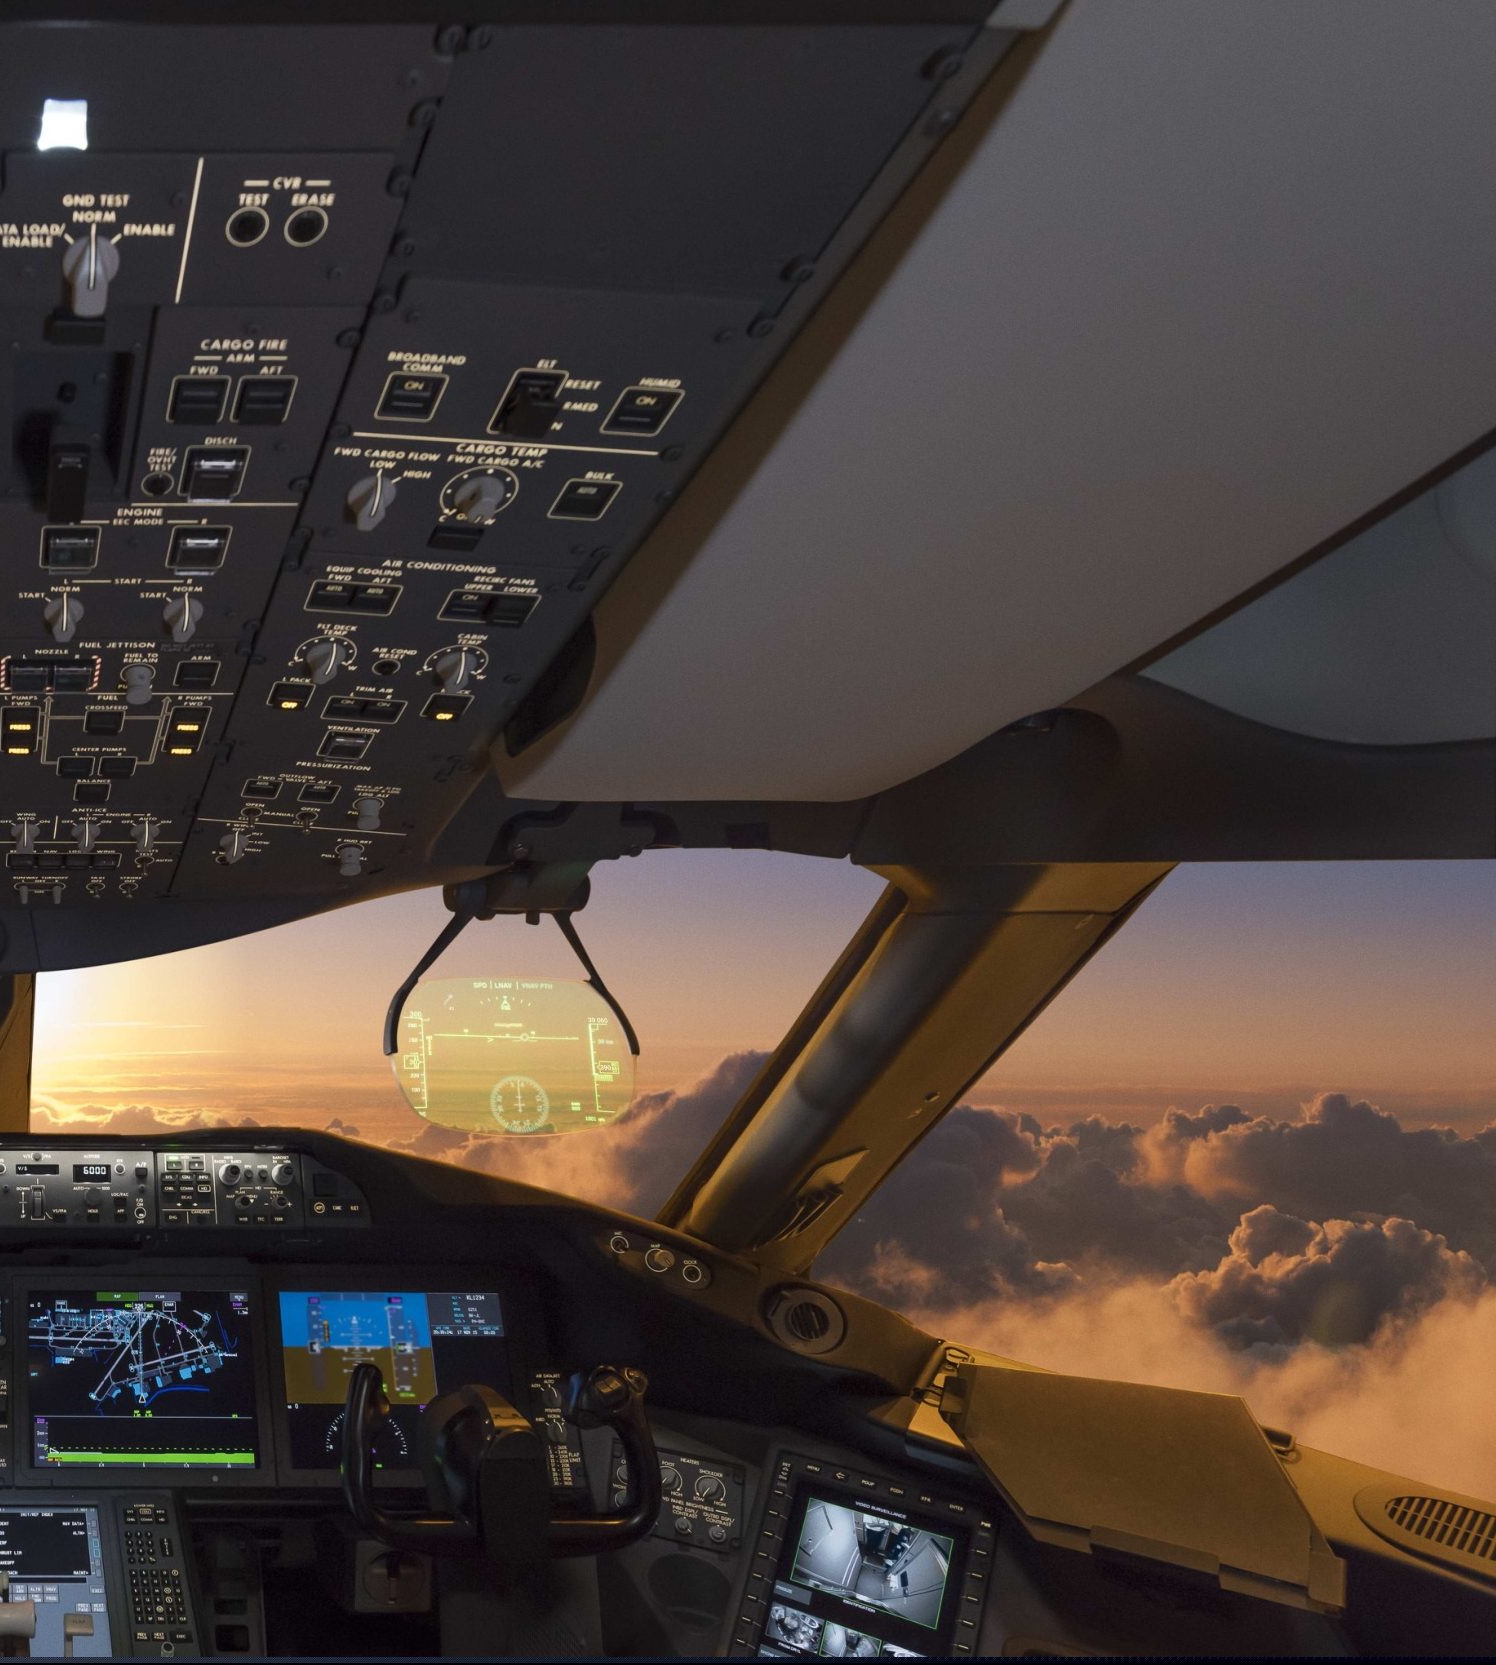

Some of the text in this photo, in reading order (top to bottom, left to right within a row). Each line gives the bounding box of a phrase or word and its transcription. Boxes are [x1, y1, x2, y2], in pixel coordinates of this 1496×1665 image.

[273, 177, 302, 190] CVR
[62, 195, 129, 207] GND TEST
[238, 194, 269, 206] TEST
[291, 194, 335, 206] ERASE
[73, 211, 116, 223] NORM
[23, 224, 65, 236] LOAD/
[123, 224, 175, 236] ENABLE
[2, 236, 53, 248] ENABLE
[201, 339, 288, 351] CARGO FIRE
[226, 353, 255, 364] ARM
[388, 352, 466, 365] BROADBAND
[537, 359, 557, 369] ELT
[190, 366, 219, 375] FWD
[259, 366, 283, 375] AFT
[403, 363, 443, 373] COMM
[404, 380, 425, 391] ON
[565, 379, 601, 391] RESET
[639, 377, 681, 388] HUMID
[635, 395, 658, 406] ON
[204, 436, 237, 445] DISCH
[149, 448, 177, 456] FIRE/
[334, 447, 441, 462] FWD CARGO FLOW
[456, 443, 548, 458] CARGO TEMP
[147, 455, 177, 464] OVHT
[369, 459, 396, 469] LOW
[447, 454, 545, 469] FWD CARGO A/C
[149, 463, 172, 472] TEST
[403, 470, 432, 480] HIGH
[117, 508, 163, 517] ENGINE
[112, 517, 164, 526] EEC MODE
[326, 565, 403, 577] EQUIP COOLING
[382, 559, 497, 574] AIR CONDITIONING
[114, 577, 142, 585] START
[328, 574, 352, 582] FWD
[473, 576, 536, 586] RECIRC FANS
[457, 633, 488, 641] CABIN
[281, 701, 298, 709] OFF
[327, 725, 380, 733] VENTILATION
[296, 761, 372, 772] PRESSURIZATION
[83, 1166, 107, 1175] 6000
